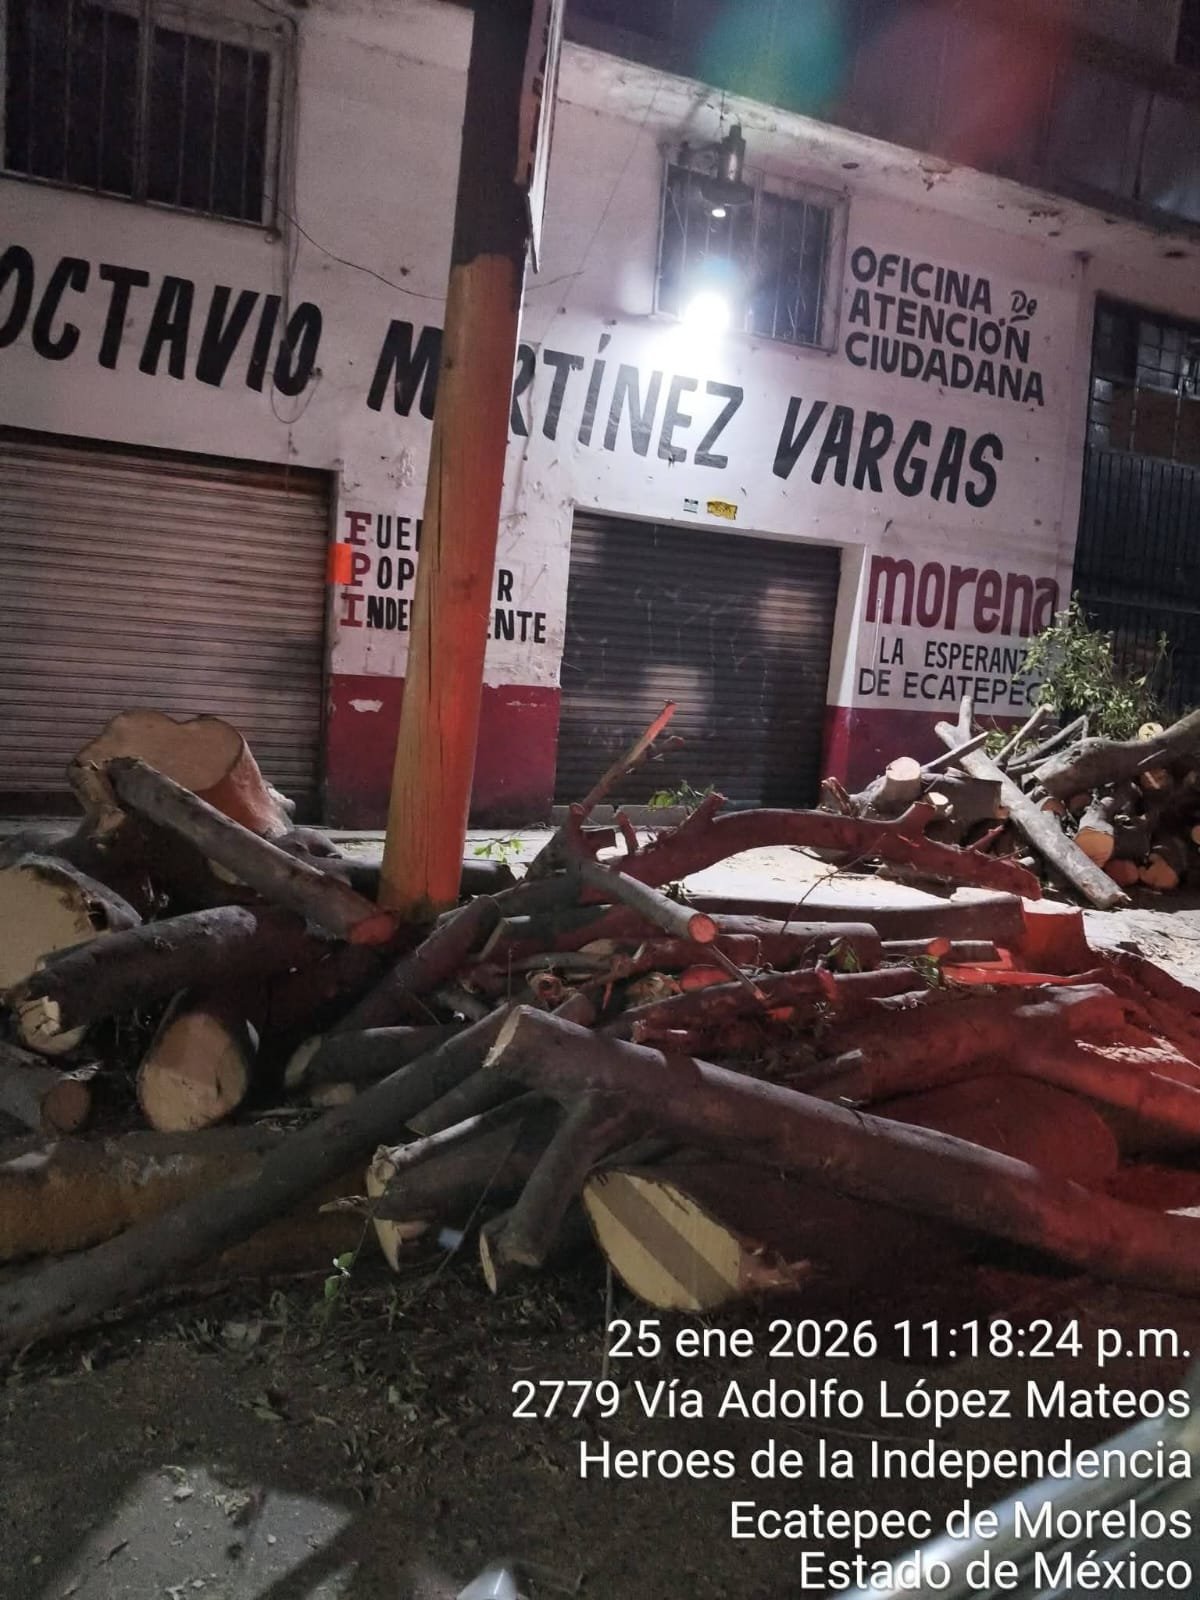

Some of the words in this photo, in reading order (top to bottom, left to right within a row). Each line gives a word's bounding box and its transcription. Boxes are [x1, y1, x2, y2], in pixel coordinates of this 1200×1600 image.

[851, 246, 992, 315] OFICINA
[1010, 290, 1037, 323] De
[0, 245, 323, 396] OCTAVIO
[367, 319, 744, 469] MRTÍNEZ
[772, 396, 1003, 507] VARGAS
[845, 331, 1045, 406] CIUDADANA
[343, 551, 513, 602] POPR
[865, 555, 1060, 638] morena
[858, 668, 892, 697] DE
[880, 637, 903, 665] LA
